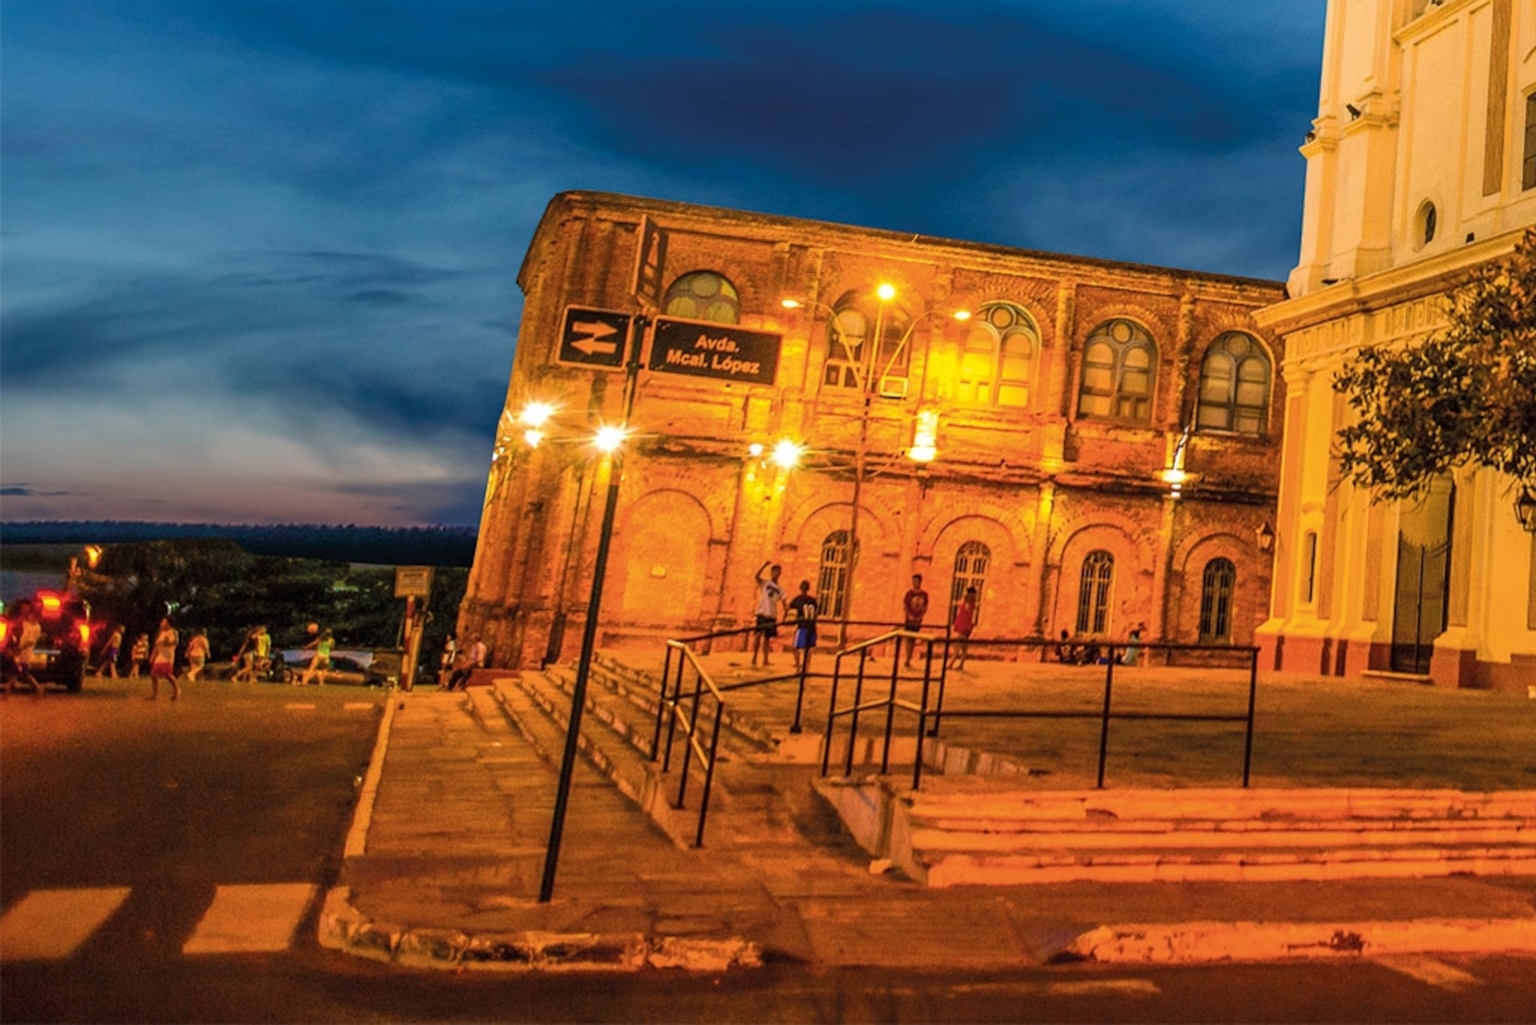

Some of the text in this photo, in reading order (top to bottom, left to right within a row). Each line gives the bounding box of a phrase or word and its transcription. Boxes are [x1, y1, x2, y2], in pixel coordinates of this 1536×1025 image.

[694, 334, 740, 353] Avda.
[666, 348, 760, 374] Mcal. López
